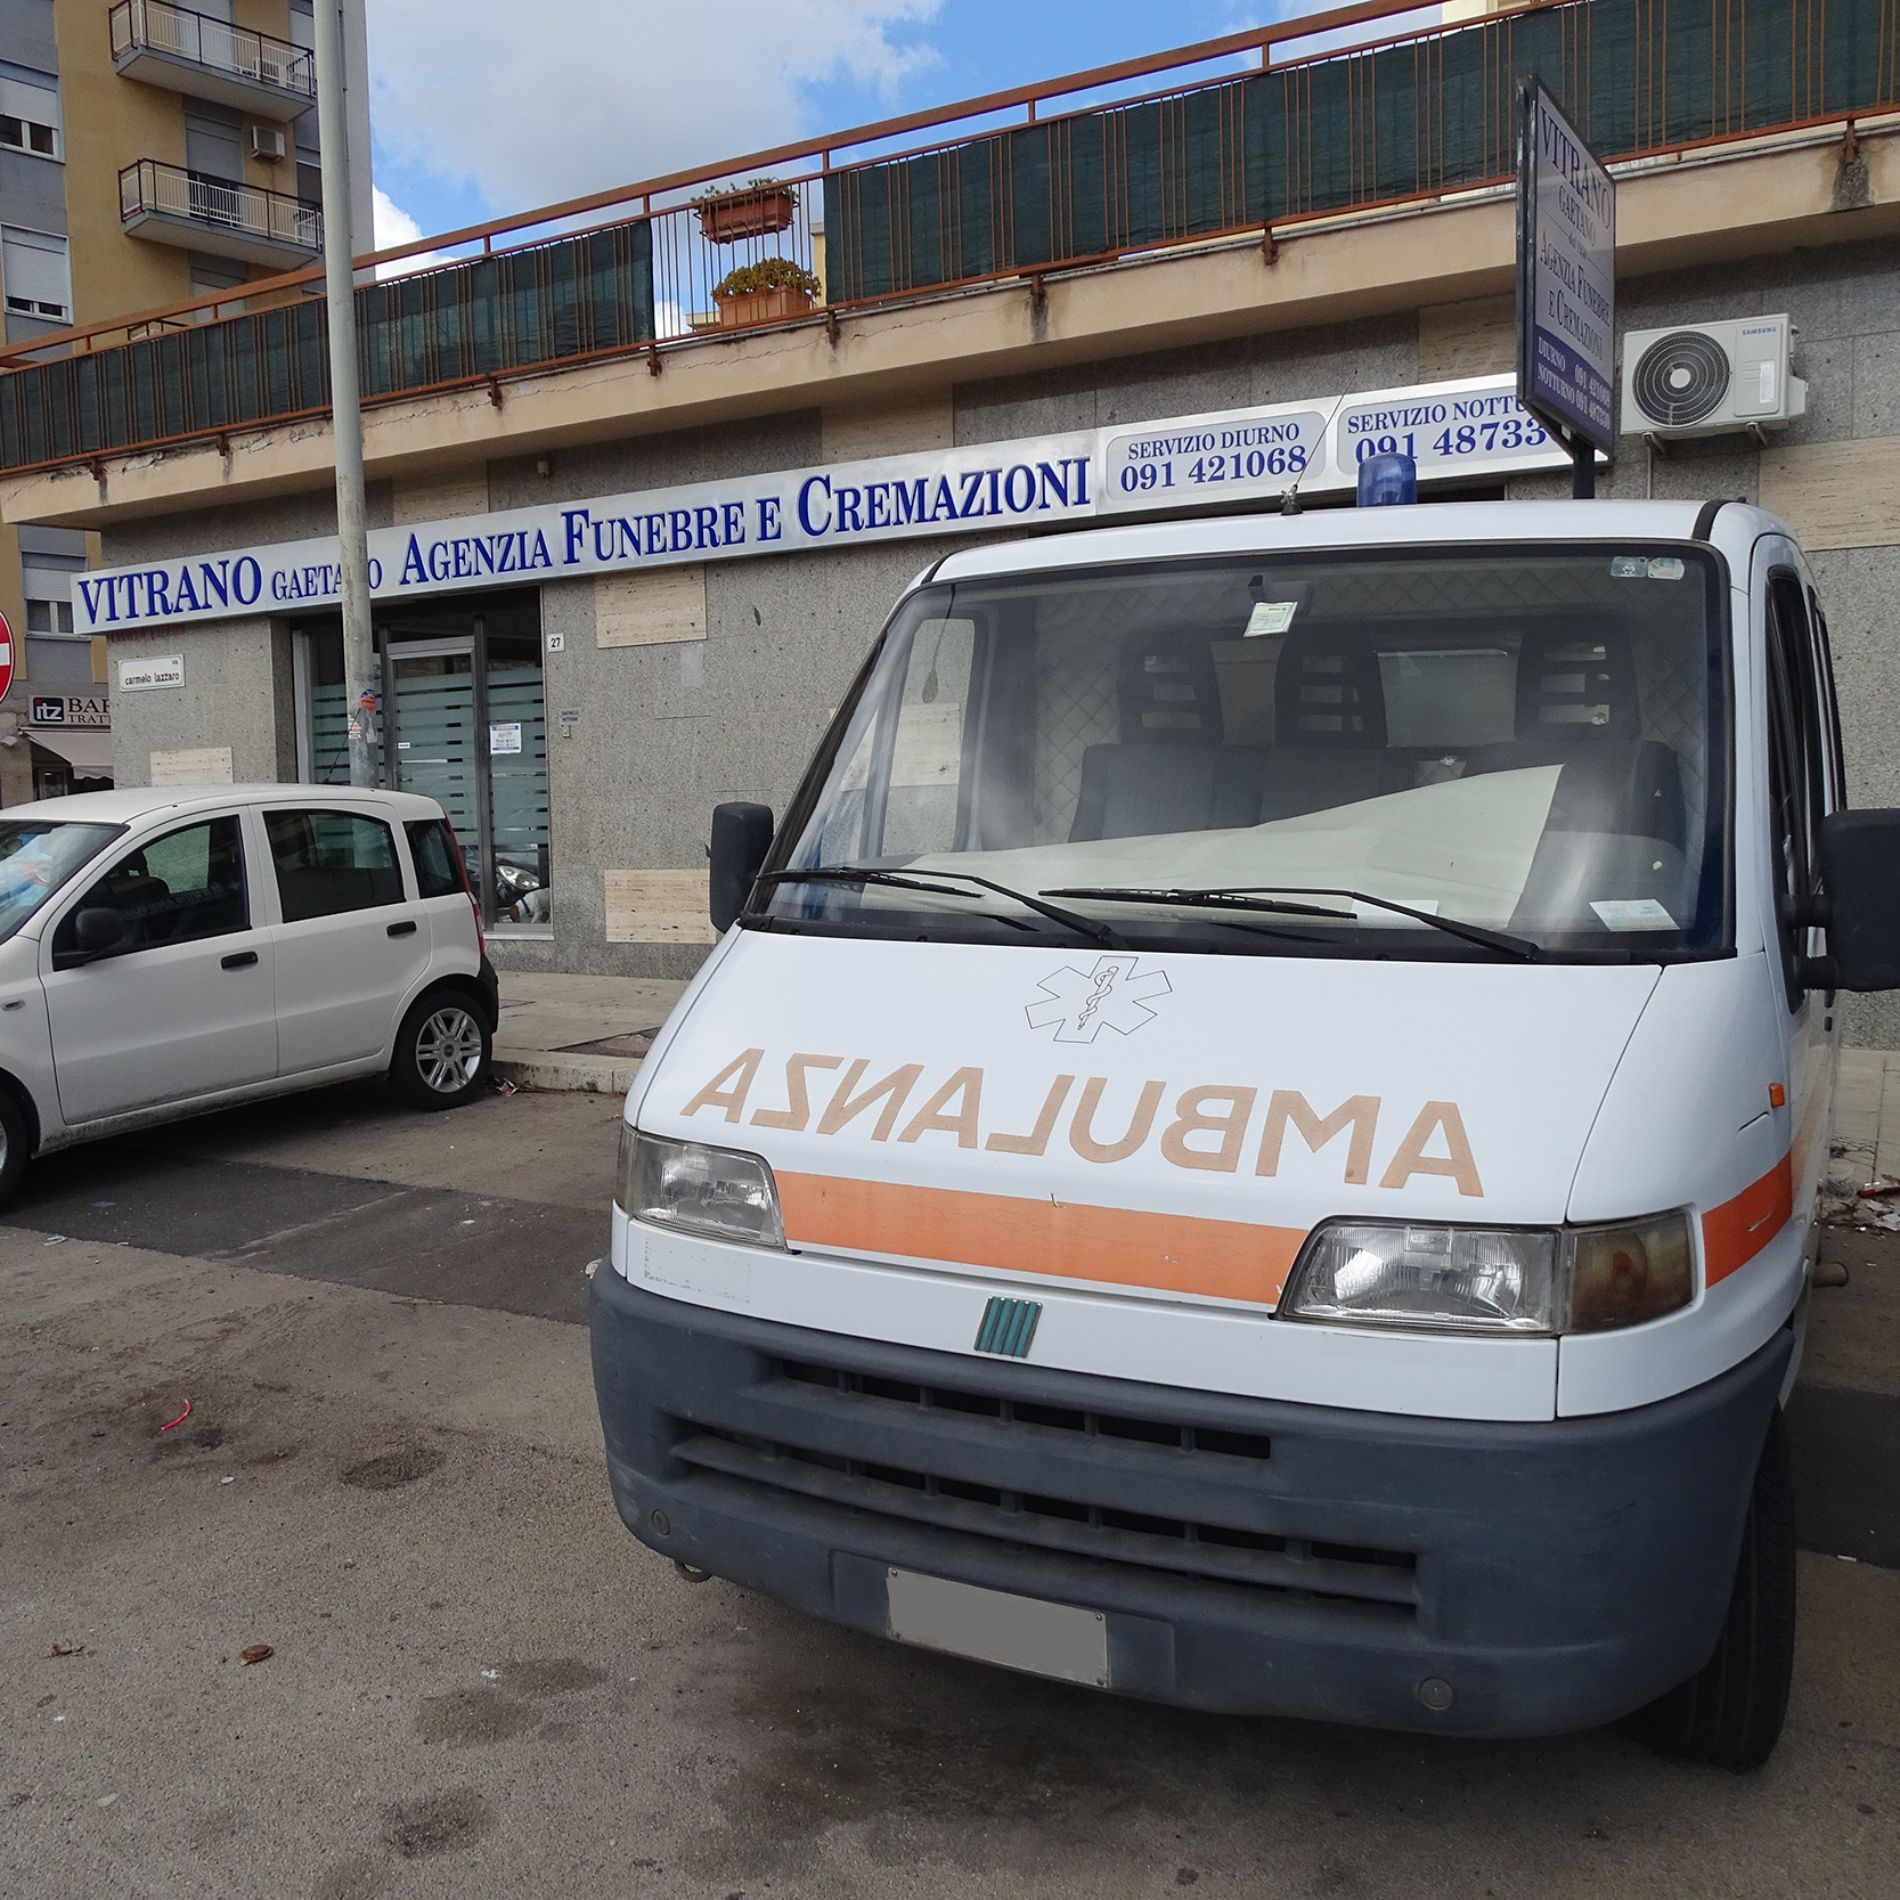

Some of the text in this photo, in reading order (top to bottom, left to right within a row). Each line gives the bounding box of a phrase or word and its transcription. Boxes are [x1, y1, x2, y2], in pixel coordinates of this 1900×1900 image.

[1540, 105, 1611, 230] VITRANO
[1558, 185, 1596, 248] GAETANO
[1540, 229, 1610, 328] AGENZIA FUNEBRE
[1548, 289, 1602, 361] E CREMAZIONI
[1742, 326, 1777, 336] SAMSUNG
[1538, 336, 1566, 372] DIURNO
[1537, 362, 1576, 405] NOTTURNO
[1348, 403, 1447, 434] SERVIZIO
[1128, 422, 1300, 460] SERVIZIO DIURNO
[1356, 432, 1418, 465] 091
[1120, 445, 1307, 492] 091 421068
[77, 456, 1092, 625] VITRANO GAETAO AGENZIA FUNEBRE E CREMAZIONI
[550, 637, 561, 648] 27
[125, 671, 180, 686] carmelo lazzaro
